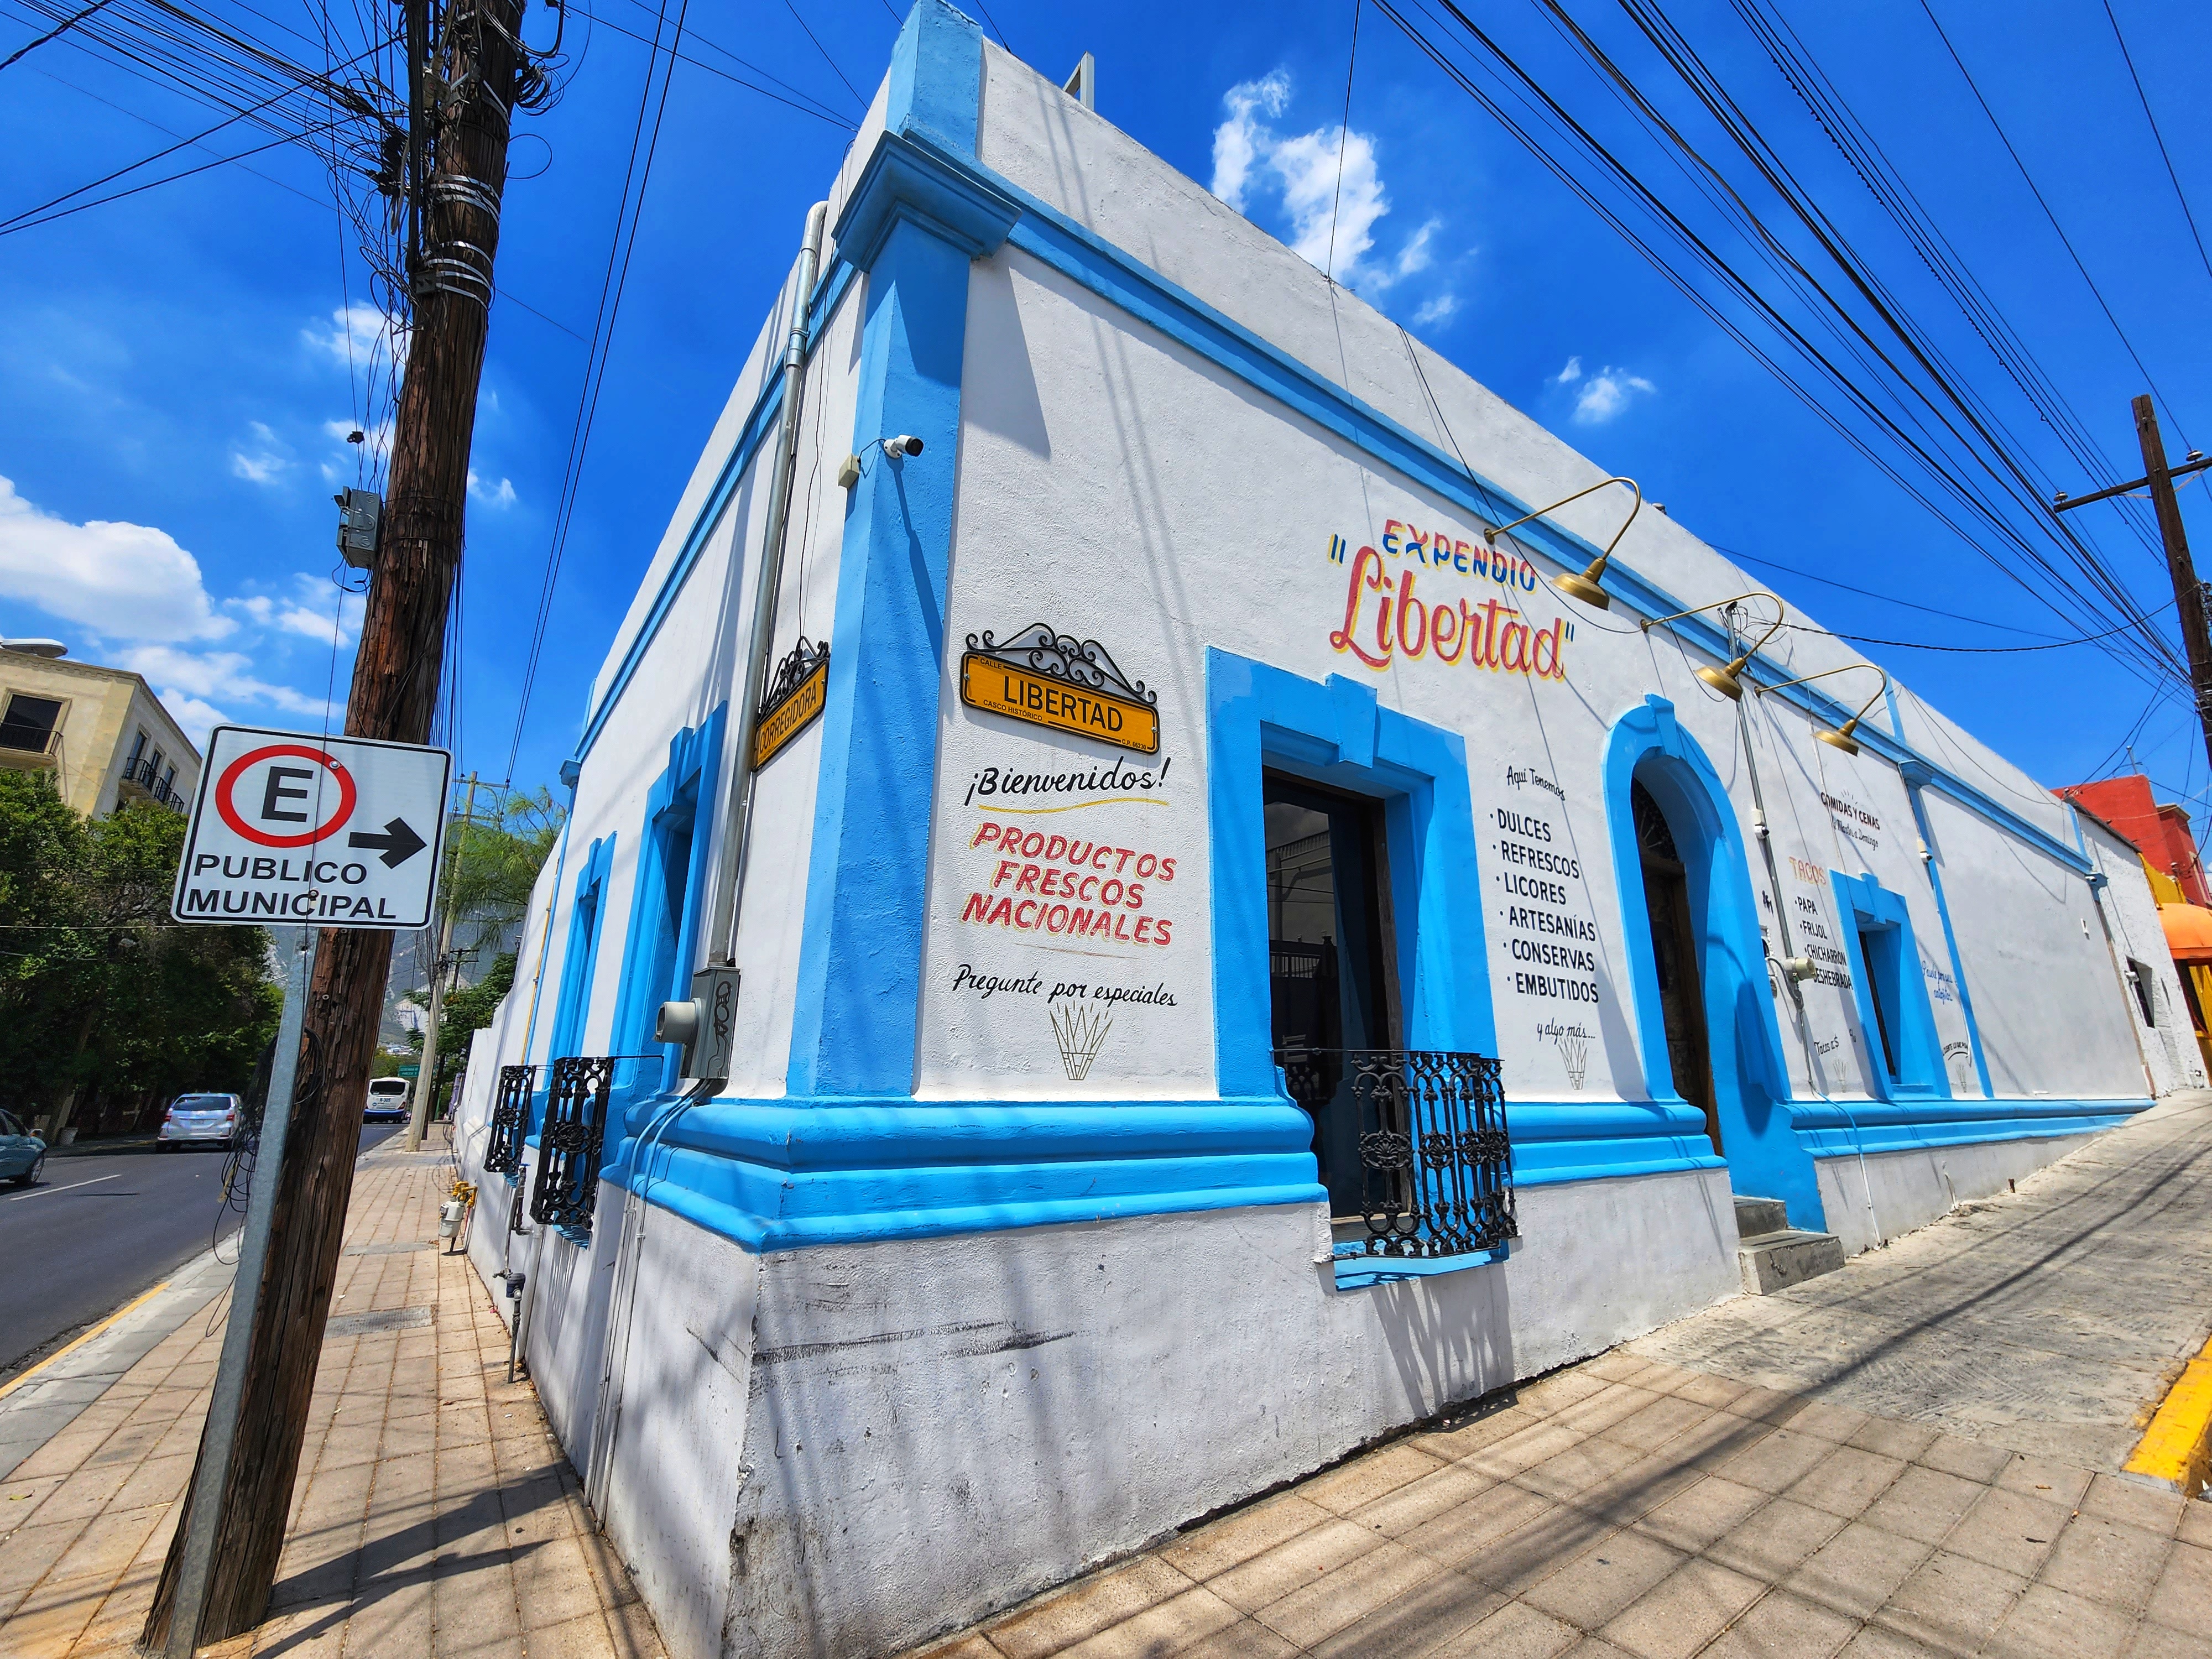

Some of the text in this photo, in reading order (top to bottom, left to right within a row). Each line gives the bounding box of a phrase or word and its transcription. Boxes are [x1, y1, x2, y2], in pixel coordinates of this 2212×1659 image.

[1383, 519, 1536, 592] EXPENDIO
[980, 658, 1002, 670] CALLE
[759, 681, 816, 754] CORREGIDORA
[983, 699, 1042, 722] CASCO HISTÓRICO
[1004, 675, 1123, 732] LIBERTAD
[261, 766, 314, 823] E
[964, 756, 1171, 806] ¡Bienvenidos!
[1529, 768, 1566, 801] Tenemos
[1497, 808, 1551, 842] DULCES
[1821, 791, 1880, 831] COMIDAS Y CENAS
[971, 822, 1177, 882] PRODUCTOS
[1859, 828, 1879, 851] Domingo
[194, 853, 368, 885] PUBLICO
[1501, 840, 1579, 879] REFRESCOS
[1789, 856, 1827, 886] TACOS
[993, 859, 1146, 910] FRESCOS
[1504, 872, 1566, 905] LICORES
[187, 889, 397, 920] MUNICIPAL
[961, 892, 1173, 946] NACIONALES
[1797, 896, 1818, 916] PAPA
[1509, 905, 1596, 942] ARTESANÍAS
[1802, 919, 1828, 940] FRIJOL
[1512, 938, 1595, 972] CONSERVAS
[1807, 943, 1847, 967] CHICHARRON
[952, 963, 1178, 1007] Pregunte por especiales
[1515, 972, 1599, 1003] EMBUTIDOS
[1537, 1023, 1542, 1042] y
[1545, 1017, 1564, 1045] algo
[1814, 1041, 1830, 1056] Tacos
